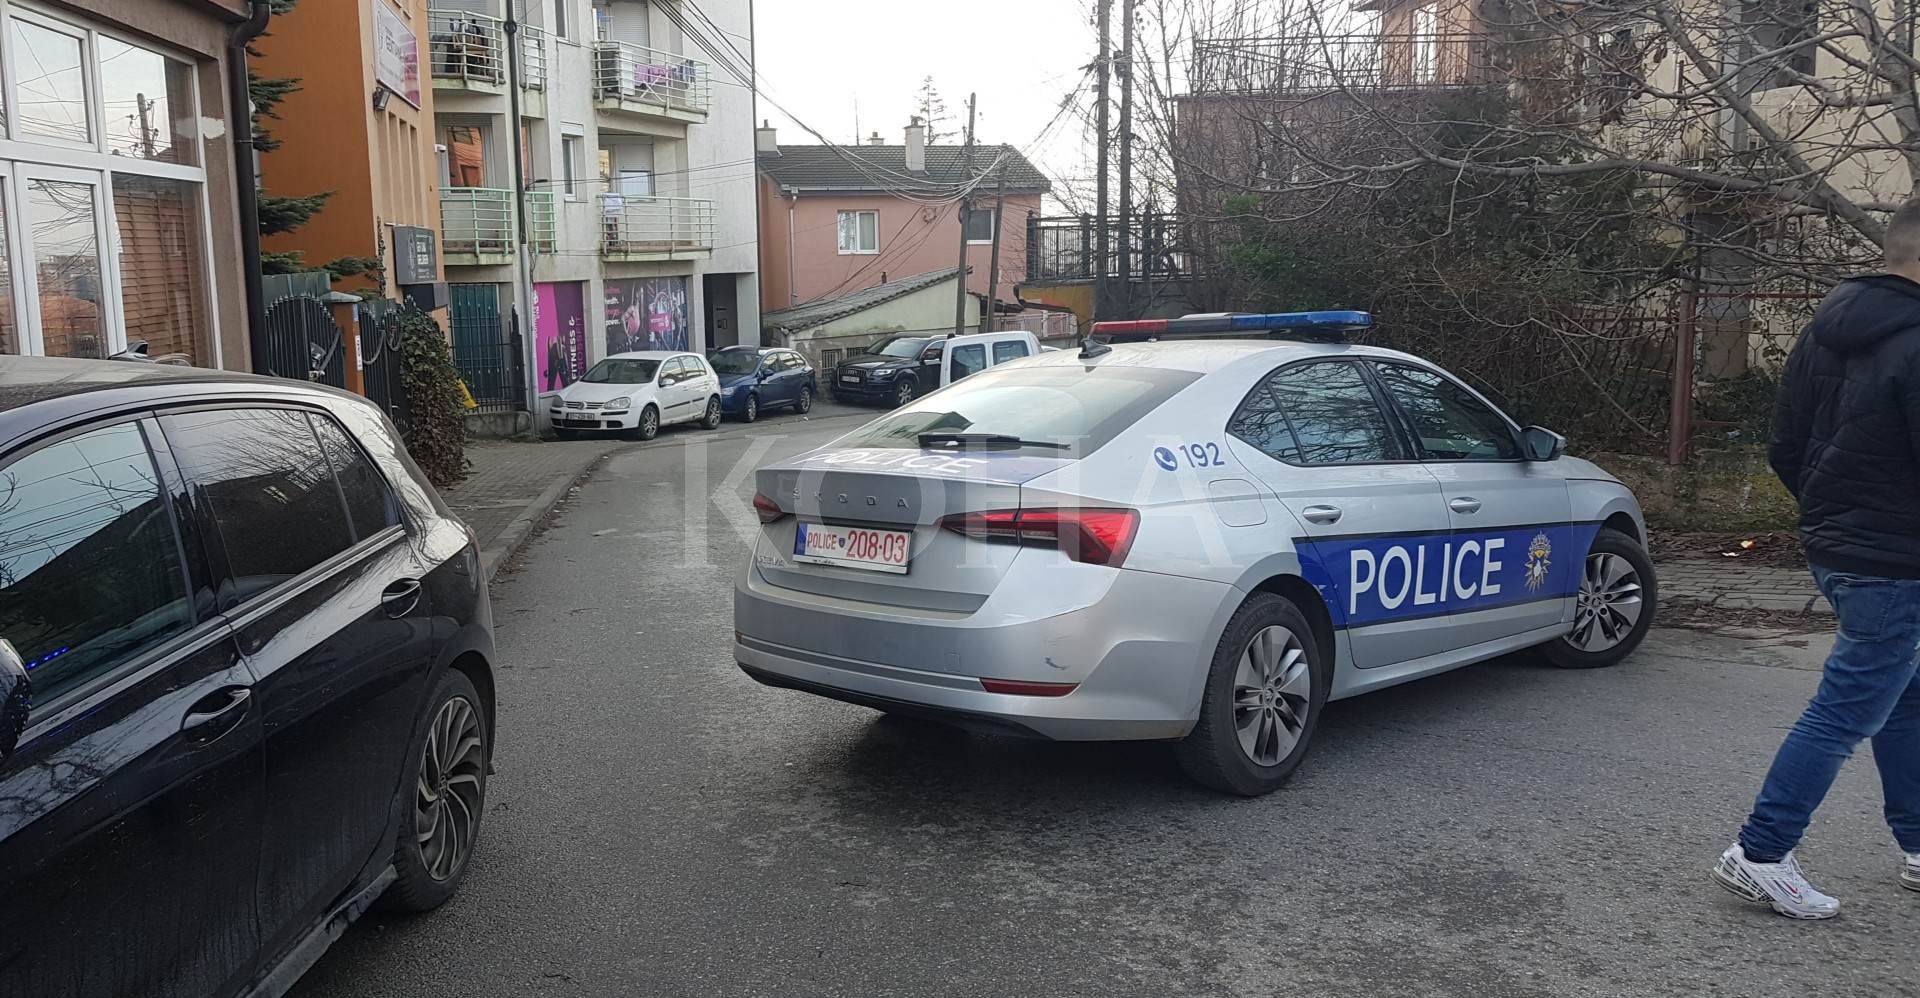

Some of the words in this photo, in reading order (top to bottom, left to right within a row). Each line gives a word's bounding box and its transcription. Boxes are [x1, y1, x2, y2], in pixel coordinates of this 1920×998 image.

[569, 330, 578, 380] FITNESS
[791, 452, 989, 474] POLICE
[1179, 442, 1225, 468] 192
[807, 531, 838, 551] POLICE
[1350, 538, 1505, 615] POLICE
